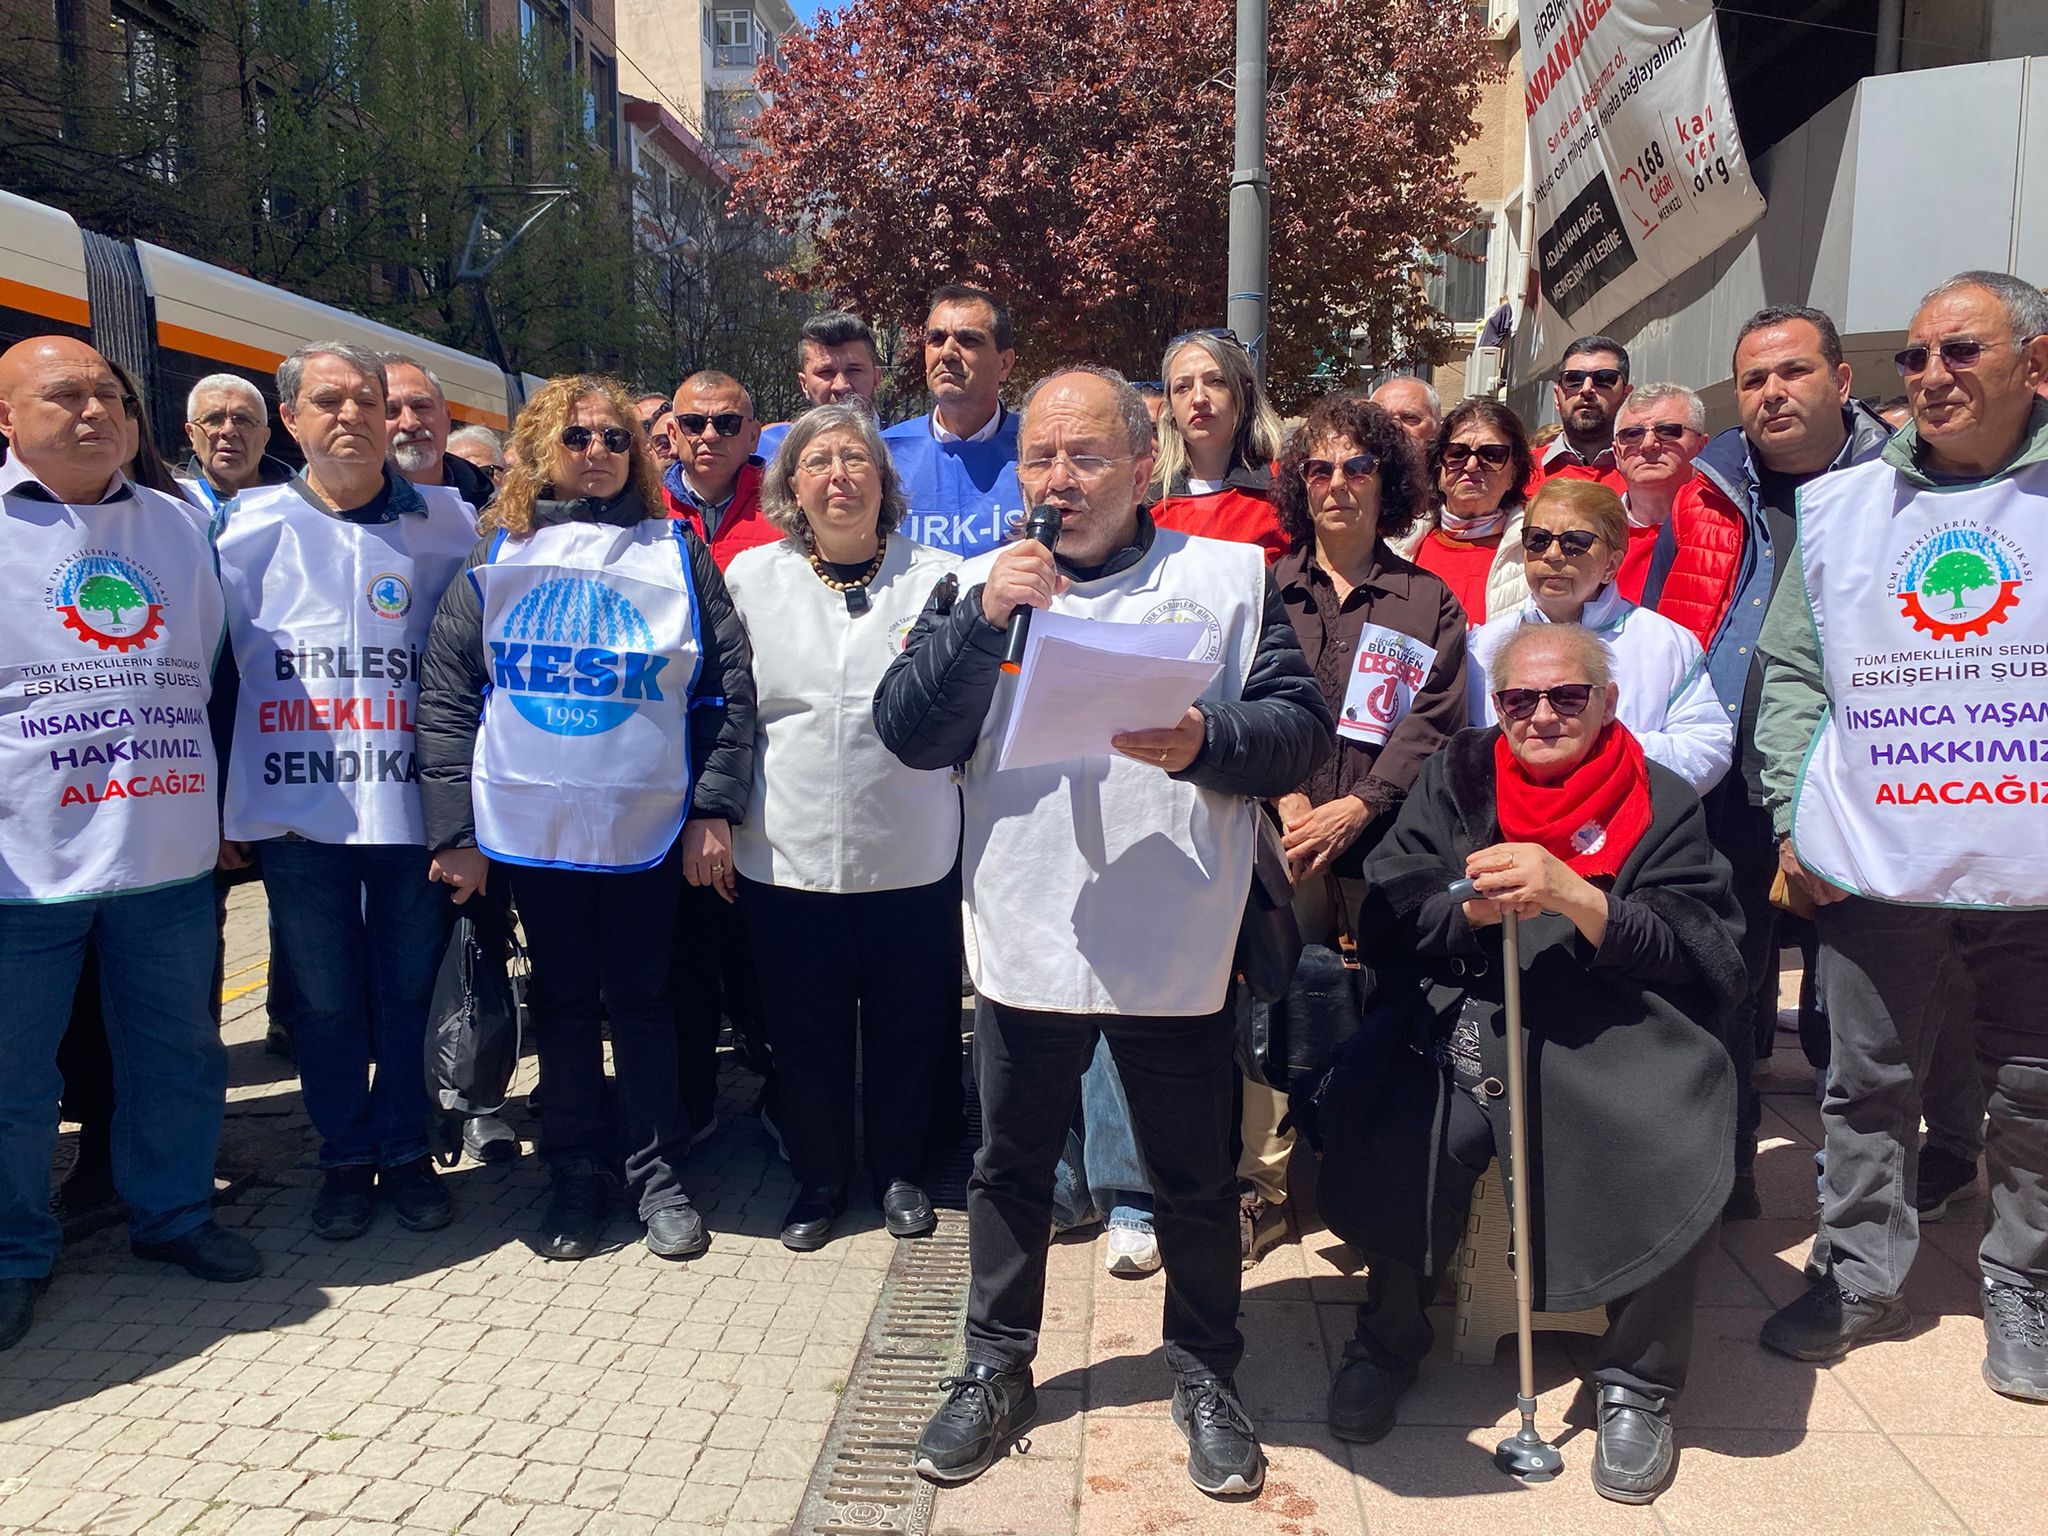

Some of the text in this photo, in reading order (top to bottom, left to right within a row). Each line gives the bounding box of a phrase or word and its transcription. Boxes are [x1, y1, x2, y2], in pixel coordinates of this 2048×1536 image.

[1618, 27, 1687, 103] bağlayalım!
[1568, 105, 1582, 128] kan
[1614, 46, 1627, 69] ol,
[1675, 104, 1713, 145] kan
[1637, 141, 1664, 183] 168
[1685, 131, 1715, 168] ver
[1649, 172, 1675, 208] ÇAĞRI
[1693, 156, 1730, 198] .org
[49, 548, 119, 583] EMEKLİLERİN
[1887, 518, 2033, 597] TÜM EMEKLİLERİN SENDİKASI
[1949, 611, 1968, 620] 2017
[275, 639, 423, 688] BİRLEŞİ
[1368, 642, 1385, 654] BU
[1855, 644, 2048, 667] TÜM EMEKLİLERİN SENDİ
[21, 657, 200, 678] TÜM EMEKLİLERİN SENDİKASI
[24, 670, 202, 697] ESKİŞEHİR ŞUBESİ
[489, 642, 670, 702] KESK
[1852, 662, 2048, 687] ESKİŞEHİR ŞUB
[20, 706, 204, 738] İNSANCA YAŞAMAK
[259, 690, 416, 733] EMEKLİL
[545, 706, 599, 729] 1995
[1846, 705, 1955, 730] İNSANCA
[264, 741, 421, 785] SENDİKA
[60, 769, 205, 807] ALACAĞIZ!
